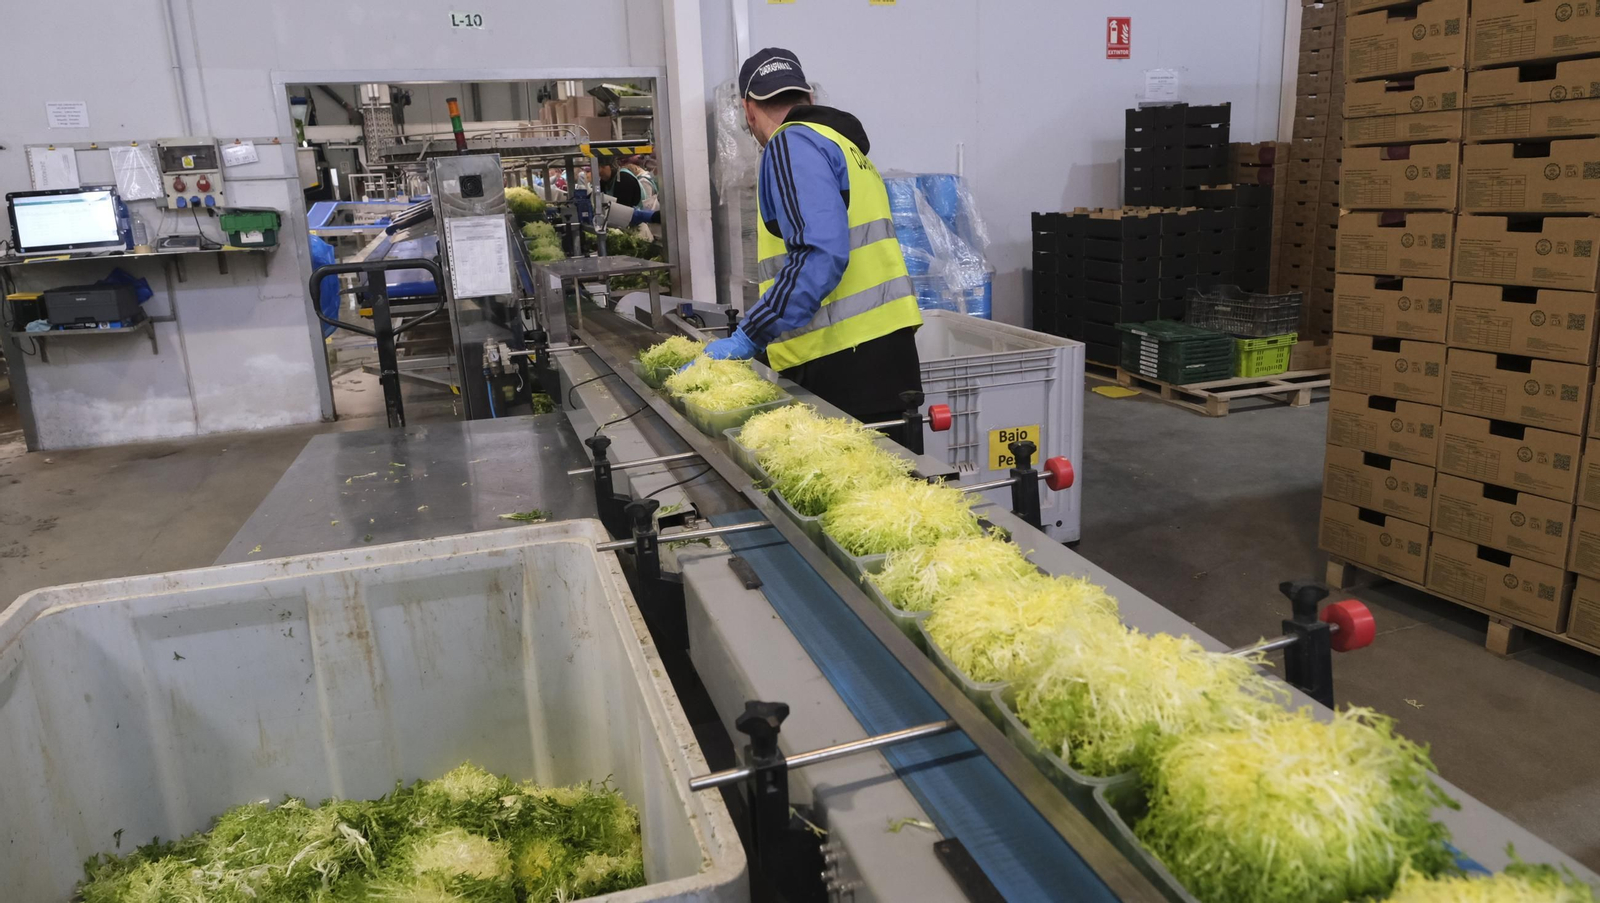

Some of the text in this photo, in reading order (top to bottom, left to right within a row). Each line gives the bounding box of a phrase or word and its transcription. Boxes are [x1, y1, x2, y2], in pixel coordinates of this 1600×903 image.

[451, 14, 483, 27] L-10
[999, 428, 1028, 443] Bajo
[998, 455, 1016, 467] Pe
